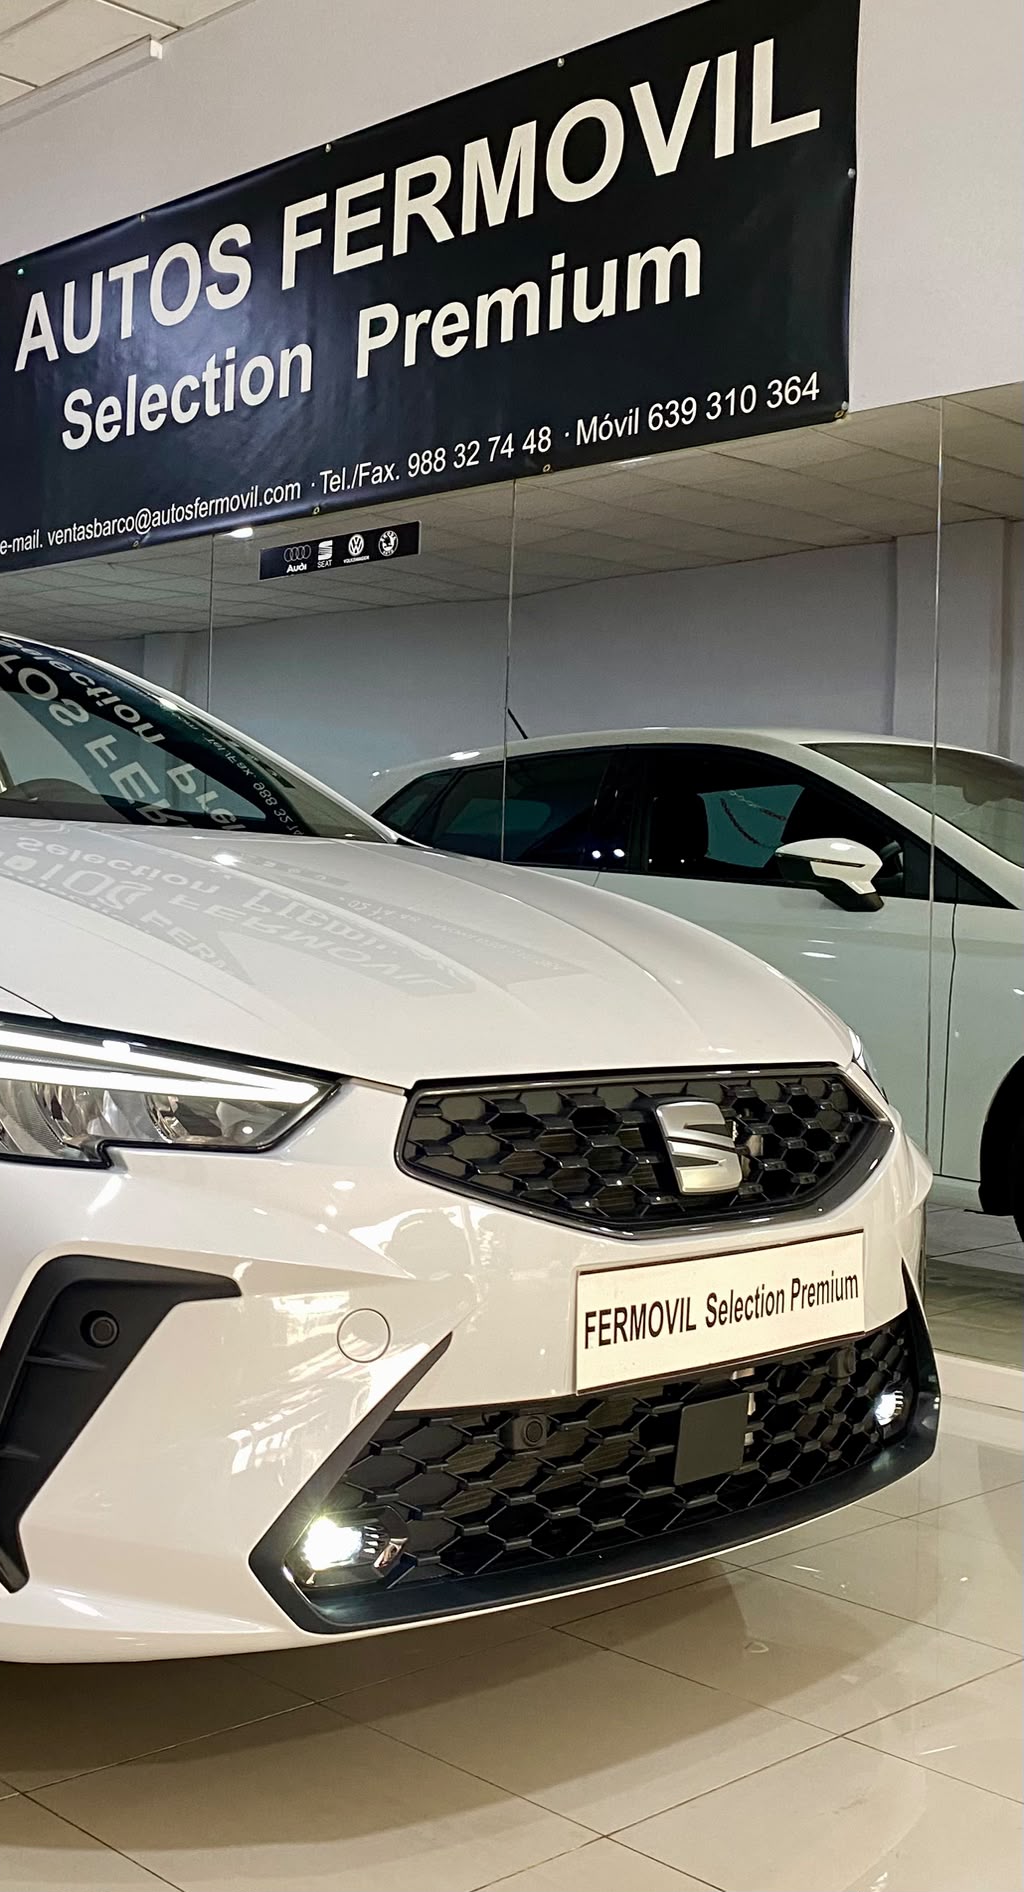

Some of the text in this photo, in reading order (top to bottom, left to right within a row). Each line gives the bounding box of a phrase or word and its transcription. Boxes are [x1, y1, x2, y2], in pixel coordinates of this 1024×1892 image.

[14, 40, 821, 372] AUTOS FERMOVIL
[62, 237, 701, 451] Selection Premium
[0, 371, 820, 555] e-mail. ventasbarco@autosfermovil.com Tel./Fax. 988 32 74 48 Móvil 639 310 364
[286, 562, 307, 574] Audi
[317, 560, 333, 568] SEAT
[584, 1270, 859, 1350] FERMOVIL Selection Premium
